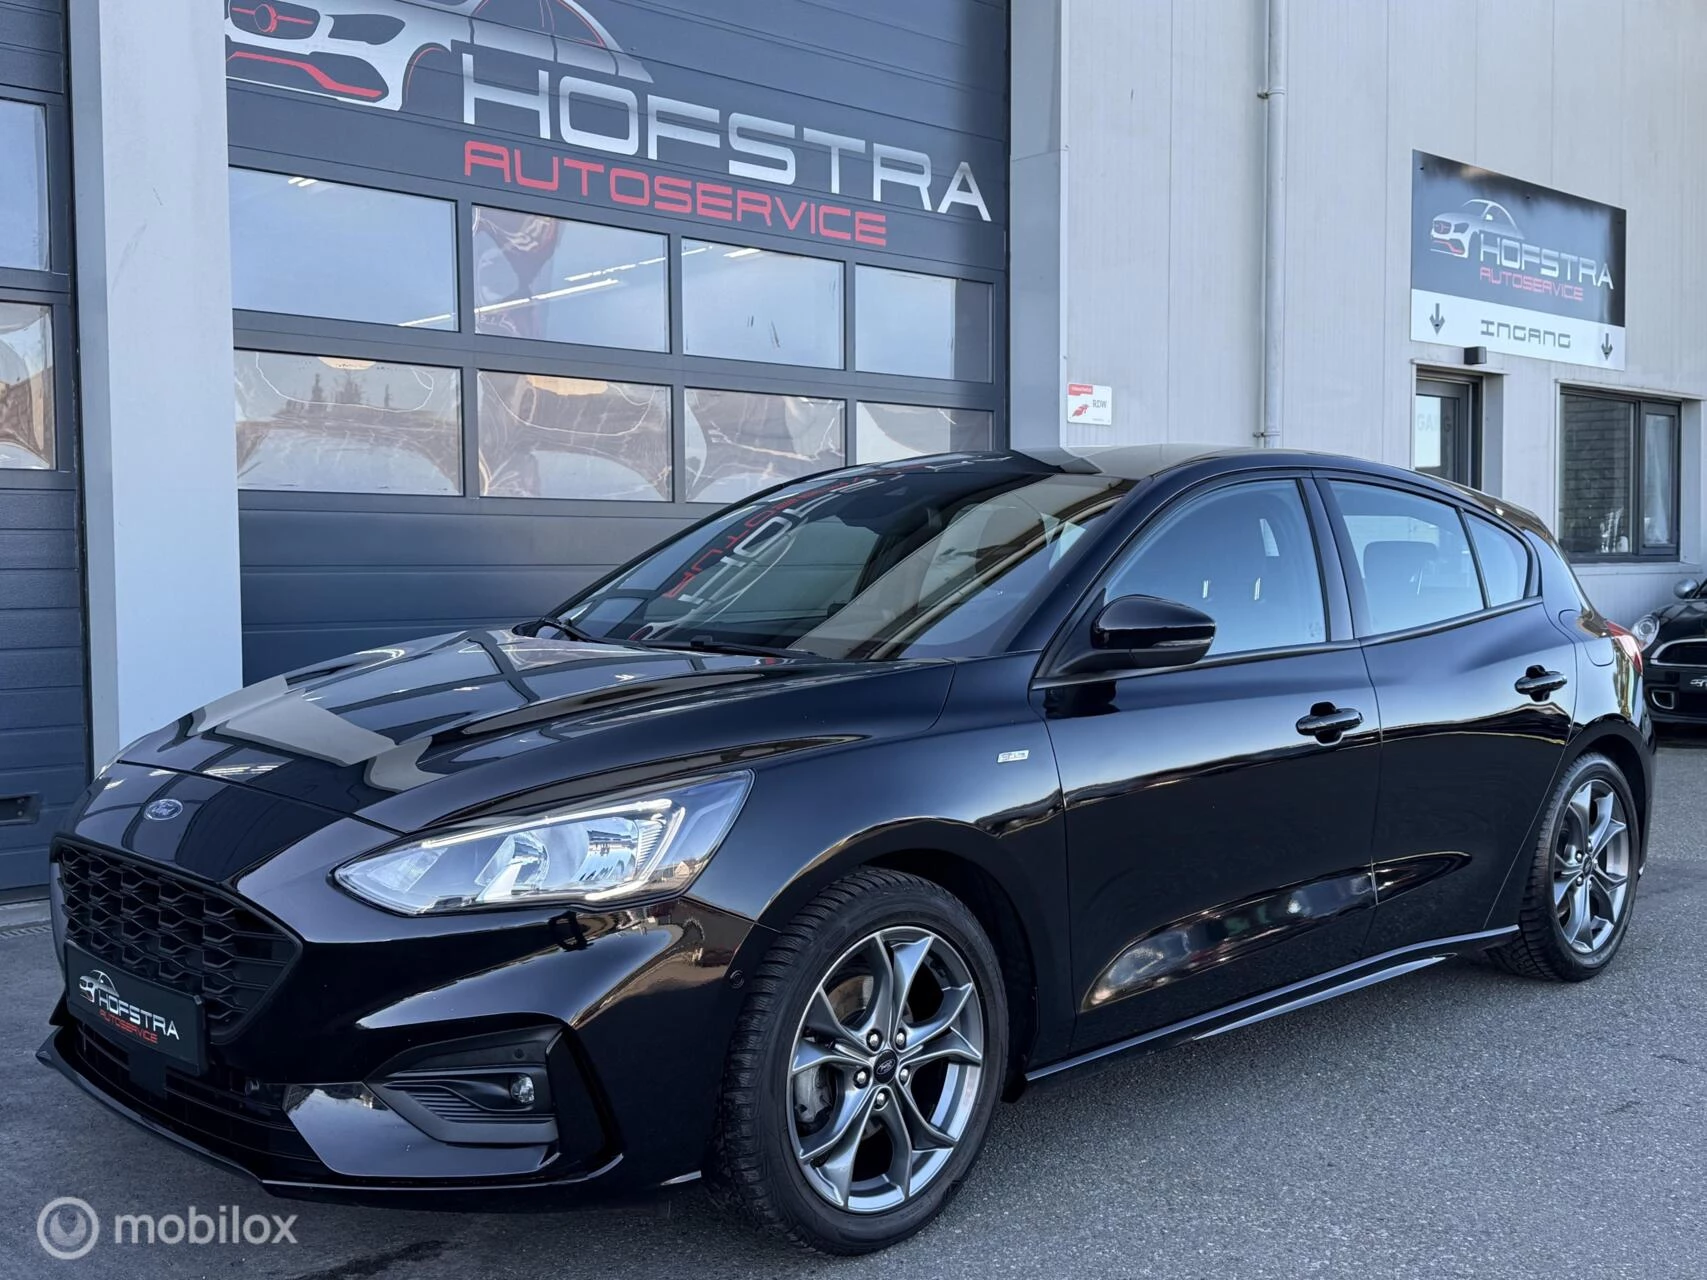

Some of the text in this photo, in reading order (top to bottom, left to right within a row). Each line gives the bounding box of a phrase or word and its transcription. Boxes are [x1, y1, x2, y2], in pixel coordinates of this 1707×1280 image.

[462, 53, 991, 221] HOFSTRA
[464, 140, 887, 246] AUTOSERVICE
[1479, 233, 1614, 290] HOFSTRA
[1479, 267, 1584, 301] AUTOSERVICE
[1480, 319, 1571, 349] INGANG
[98, 990, 180, 1040] HOFSTRA
[100, 1009, 159, 1044] AUTOSERVICE
